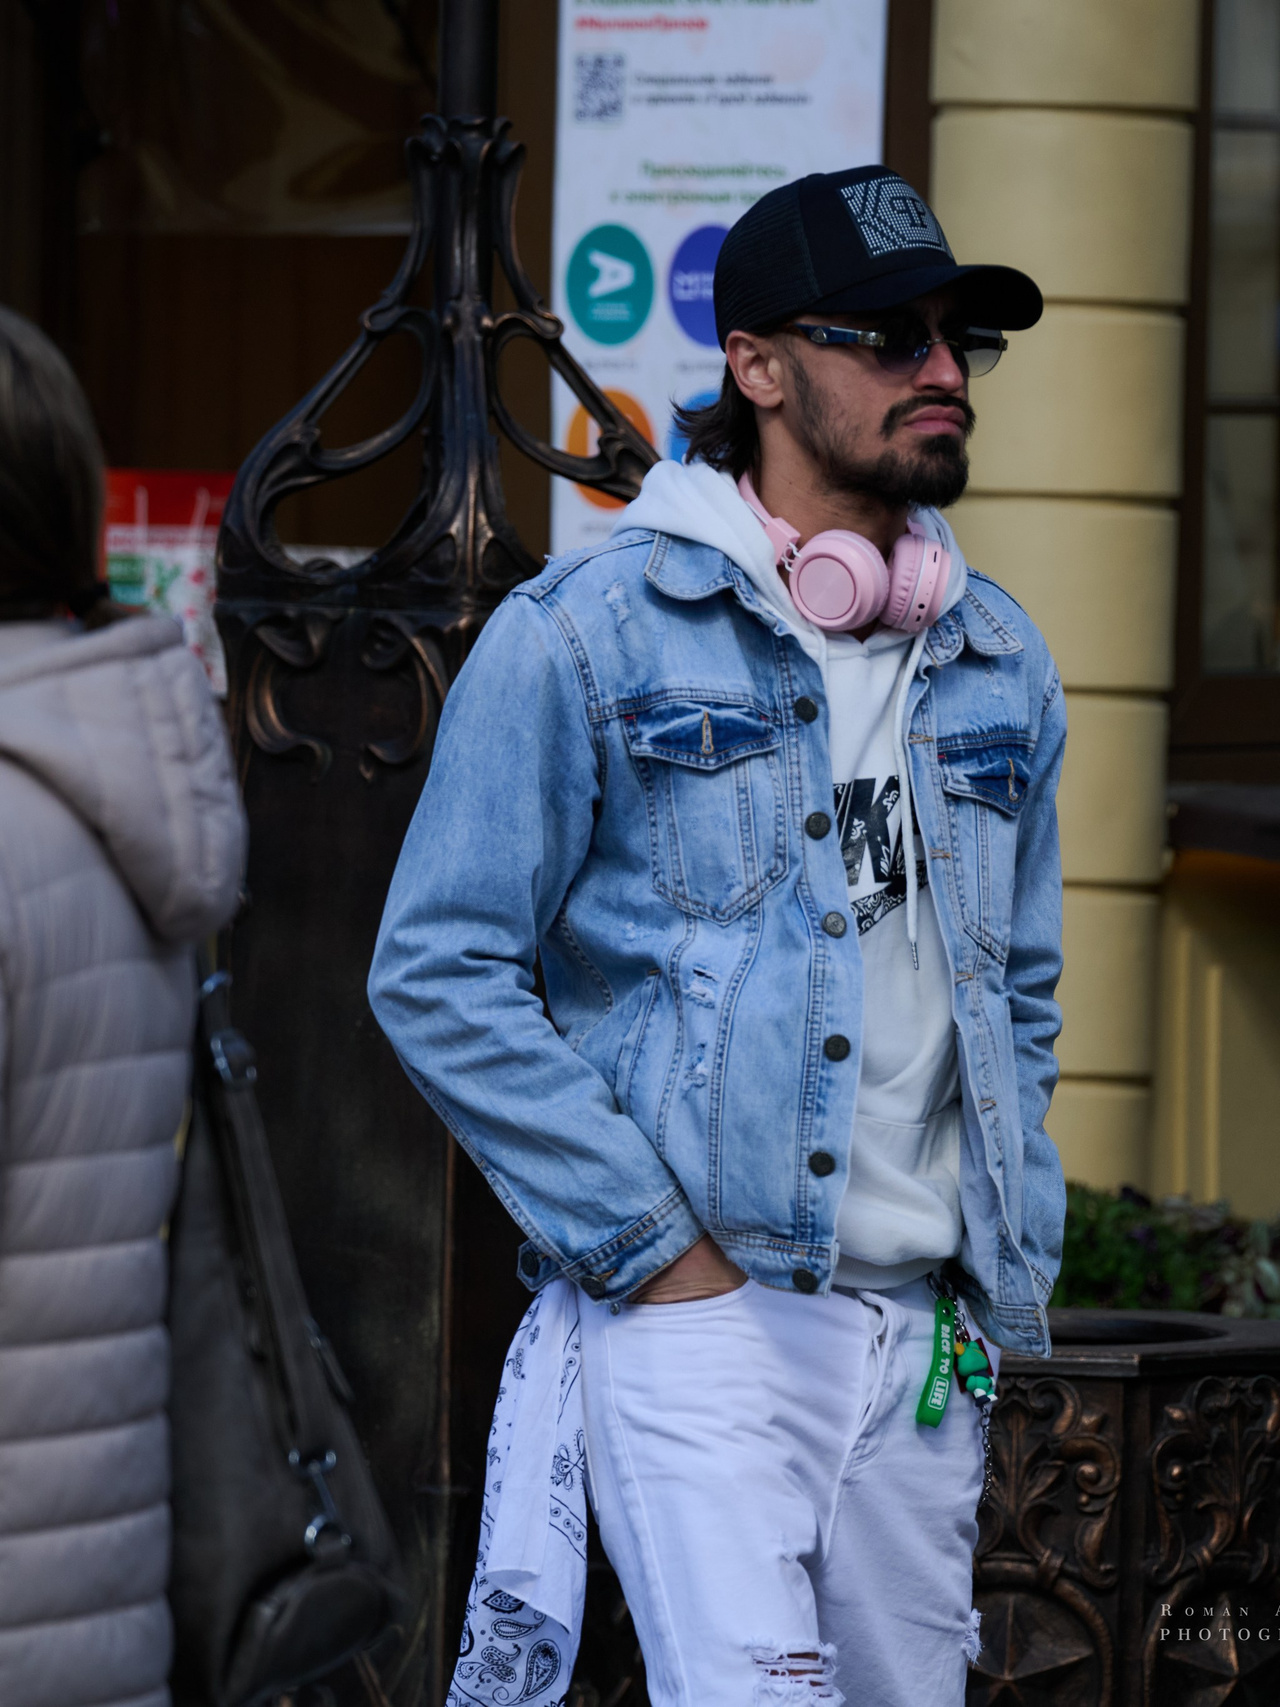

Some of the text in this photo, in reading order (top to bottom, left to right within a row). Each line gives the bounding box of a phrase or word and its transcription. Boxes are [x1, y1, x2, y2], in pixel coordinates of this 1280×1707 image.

[932, 1323, 951, 1406] BACK TO LIFE
